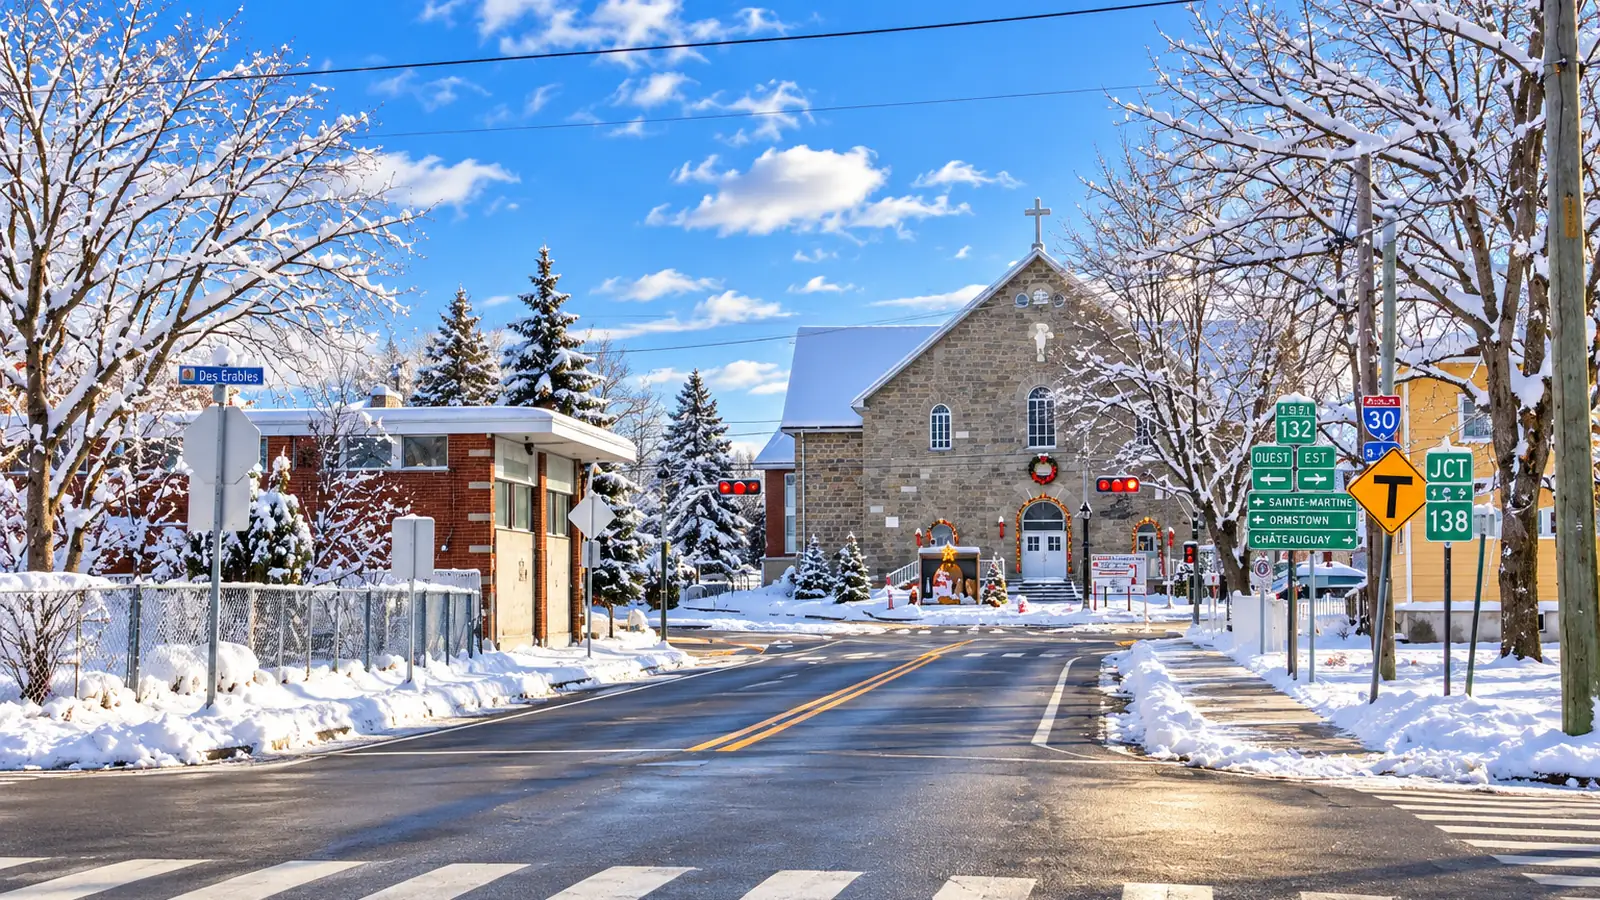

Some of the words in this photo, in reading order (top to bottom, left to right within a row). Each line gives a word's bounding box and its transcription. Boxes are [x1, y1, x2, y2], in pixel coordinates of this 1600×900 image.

[199, 369, 218, 382] Des
[1368, 410, 1395, 430] 30
[1281, 420, 1312, 438] 132
[1255, 452, 1289, 463] OUEST
[1305, 452, 1327, 463] EST
[1430, 459, 1467, 478] JCT
[1269, 497, 1353, 507] SAINTE-MARTINE
[1269, 515, 1329, 525] ORMSTOWN
[1430, 510, 1468, 532] 138
[1254, 532, 1331, 544] CHÂTEAUGUAY
